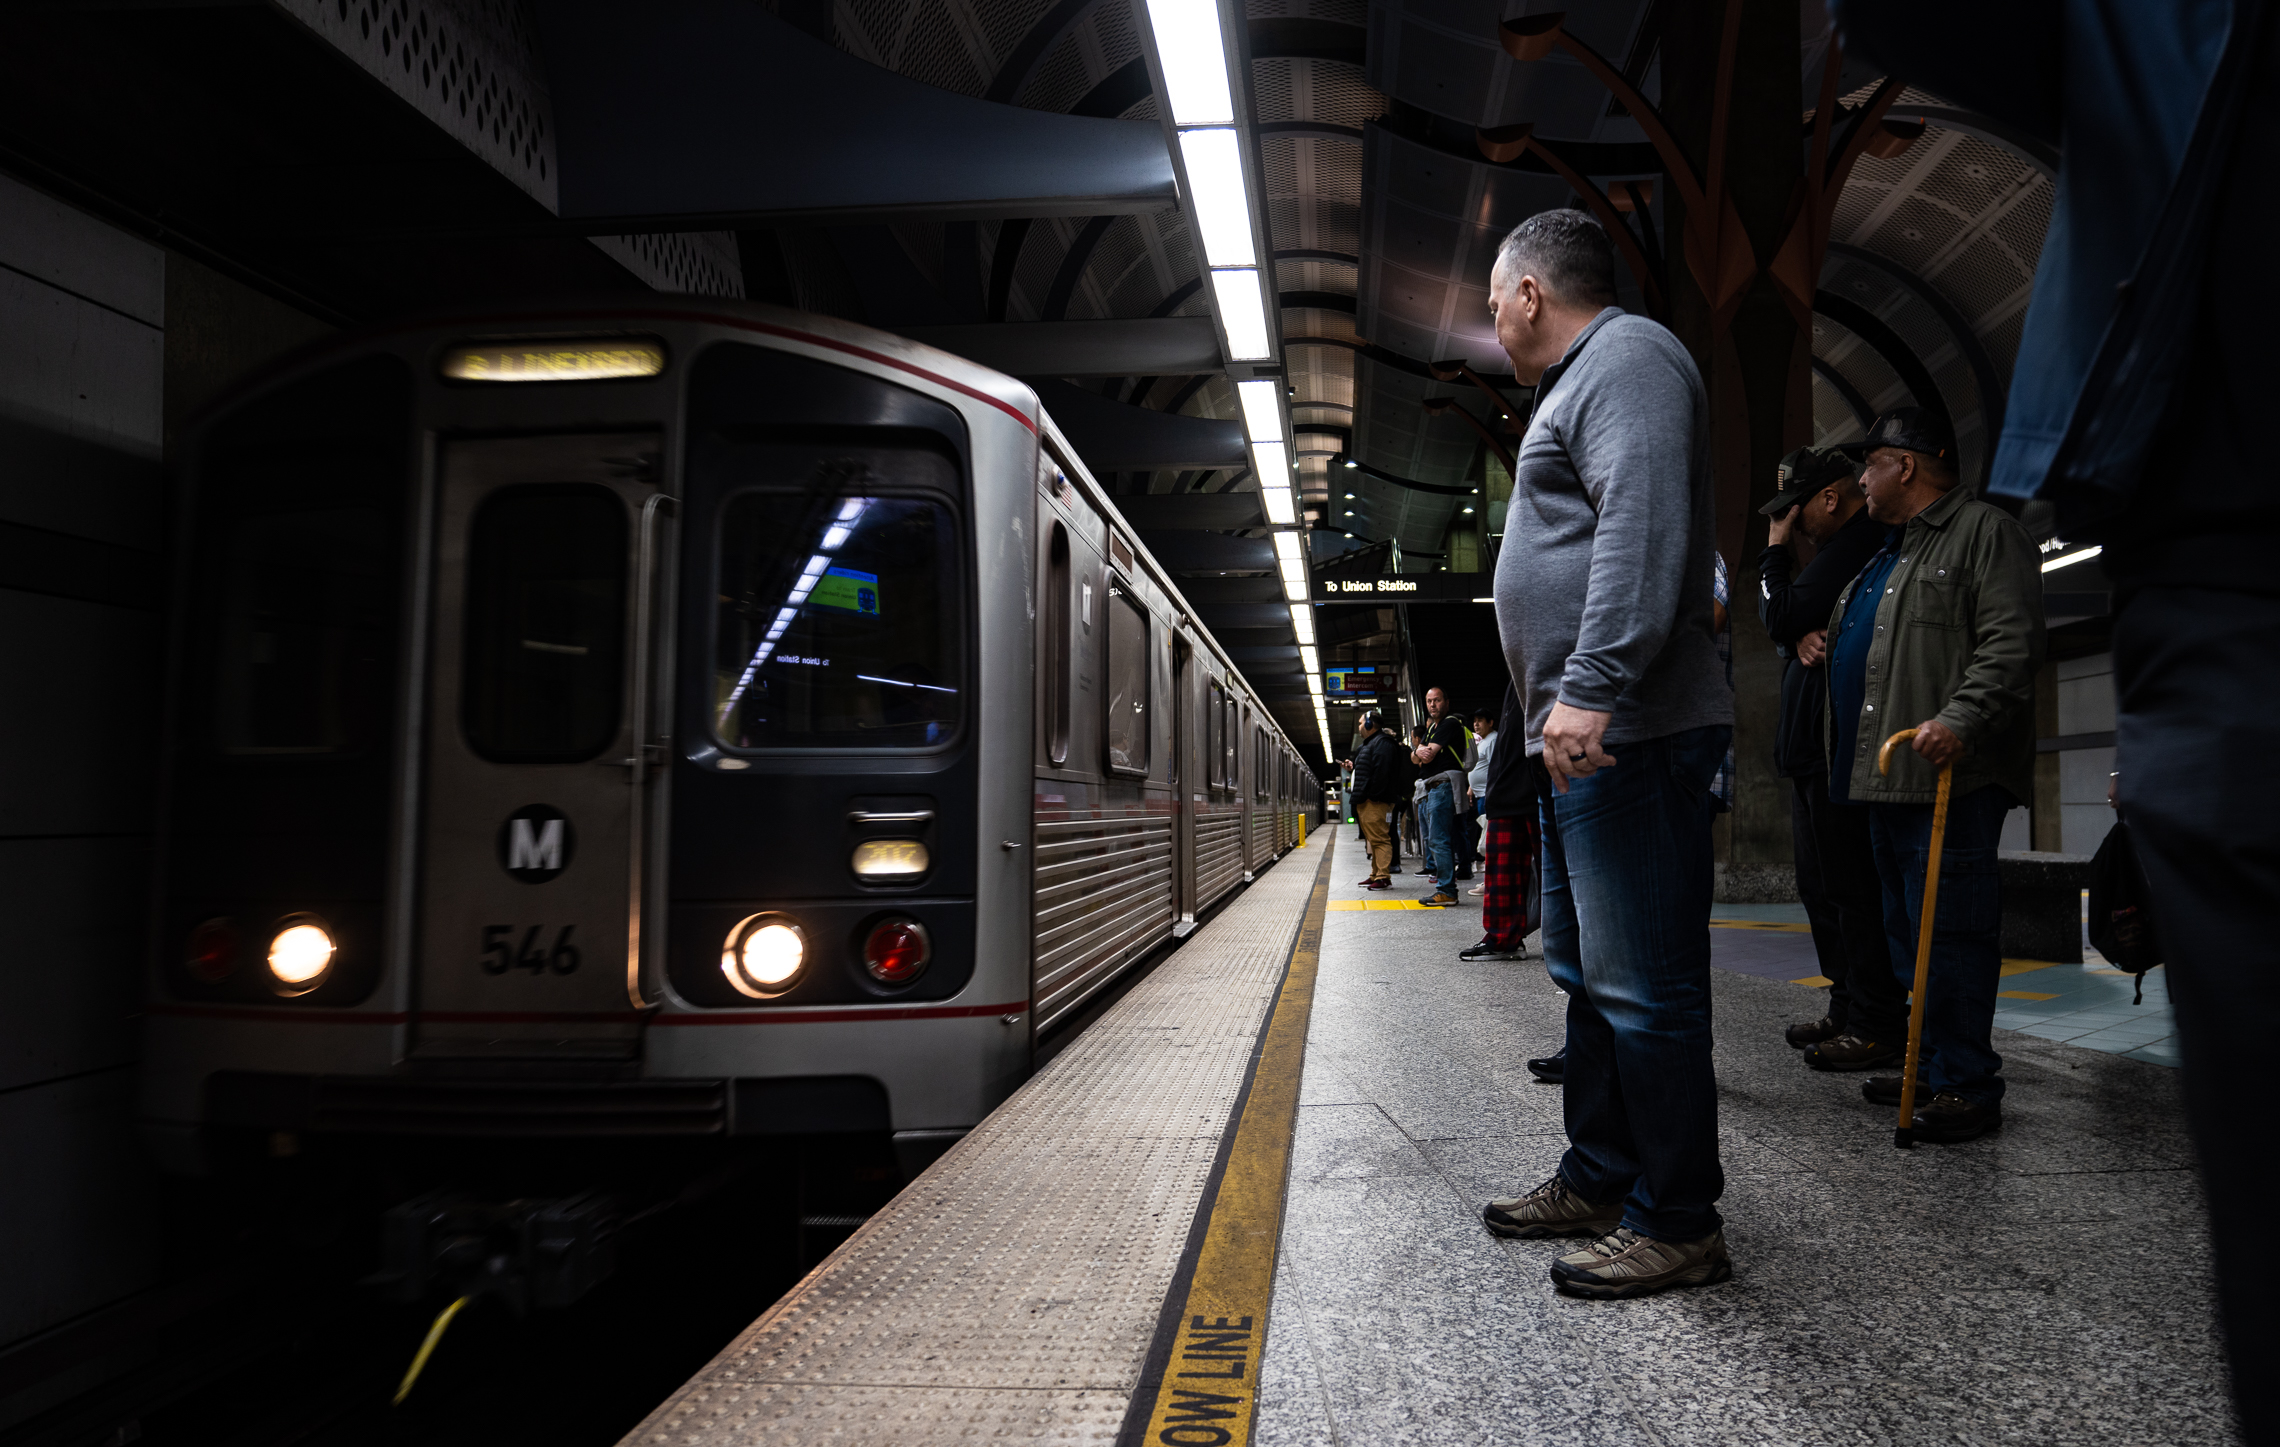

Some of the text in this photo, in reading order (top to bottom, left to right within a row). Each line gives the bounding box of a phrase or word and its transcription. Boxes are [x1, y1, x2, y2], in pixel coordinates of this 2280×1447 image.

[1325, 580, 1417, 592] To Union Station
[1347, 675, 1380, 684] Emergency
[480, 924, 582, 976] 546
[1177, 1315, 1253, 1379] LINE
